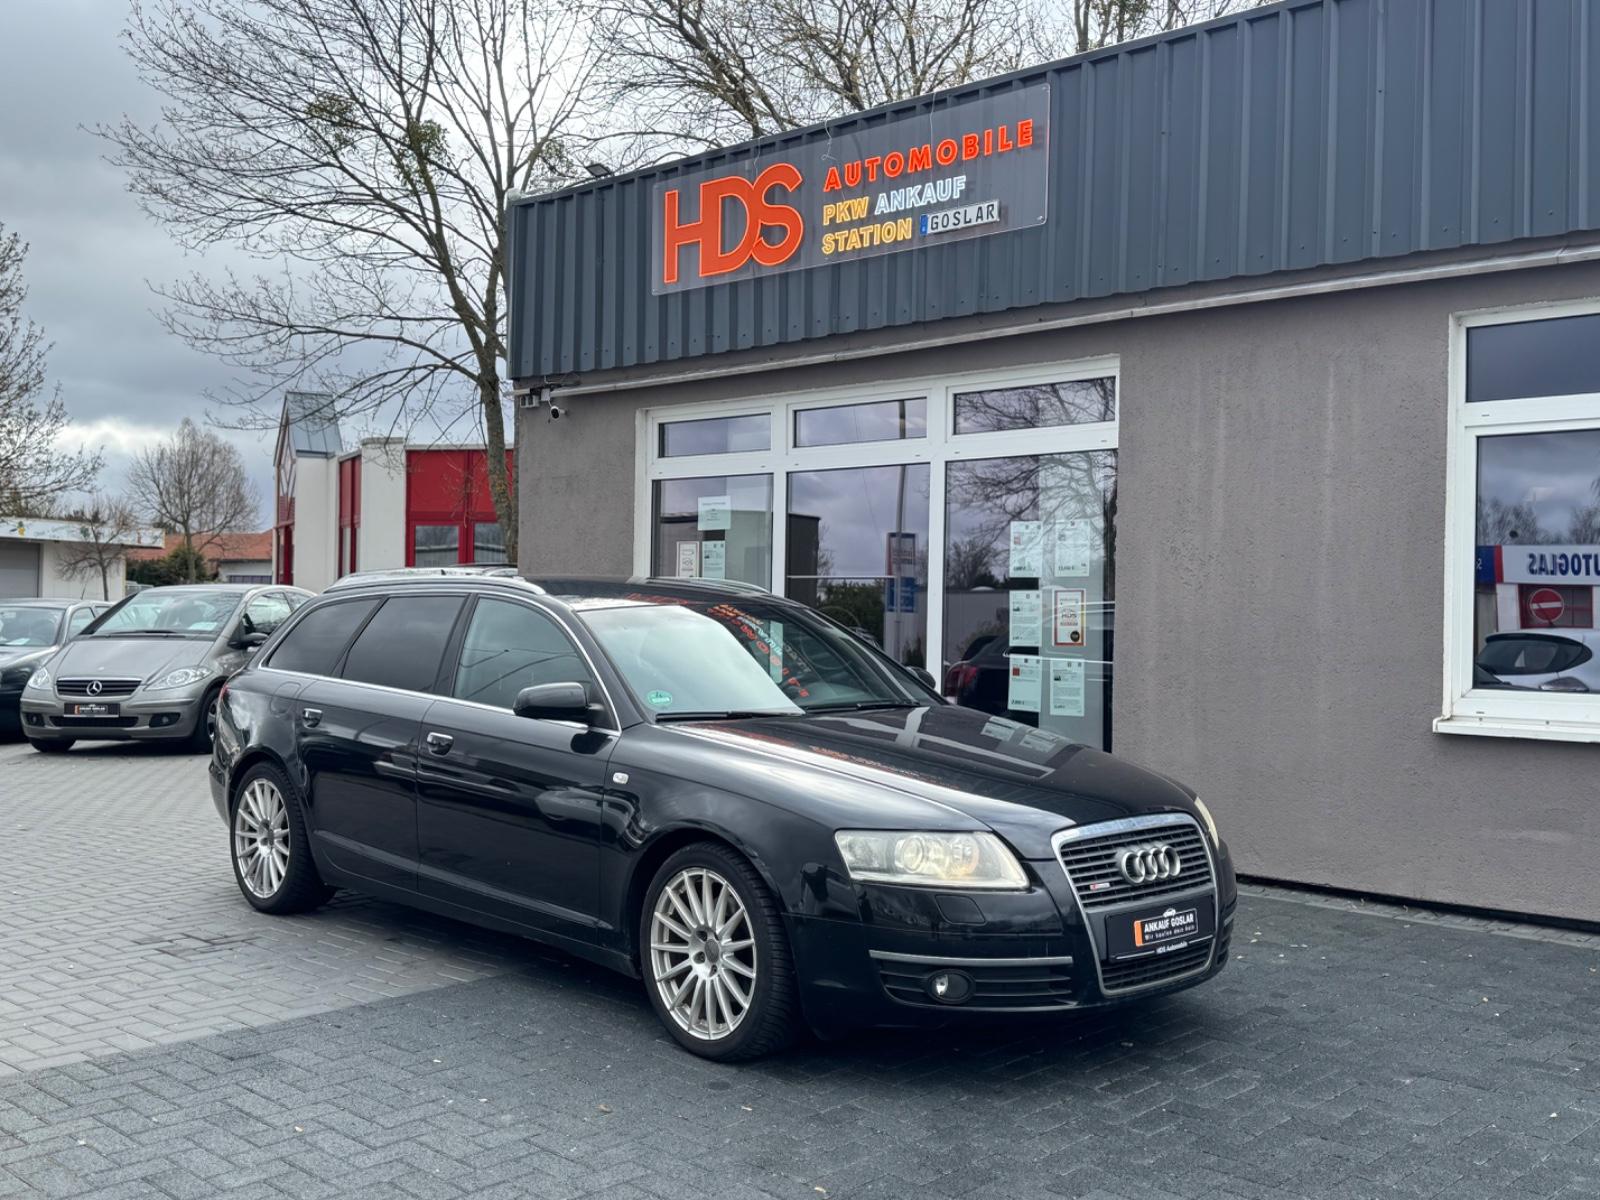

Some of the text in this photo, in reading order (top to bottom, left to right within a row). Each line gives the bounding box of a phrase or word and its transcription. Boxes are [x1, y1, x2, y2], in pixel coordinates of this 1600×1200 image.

[823, 118, 1034, 193] AUTOMOBILE
[663, 162, 804, 284] HDS
[822, 174, 967, 226] PKW ANKAUF
[821, 202, 996, 255] STATION GOSLAR
[1144, 913, 1193, 932] ANKAUF GOSLAR
